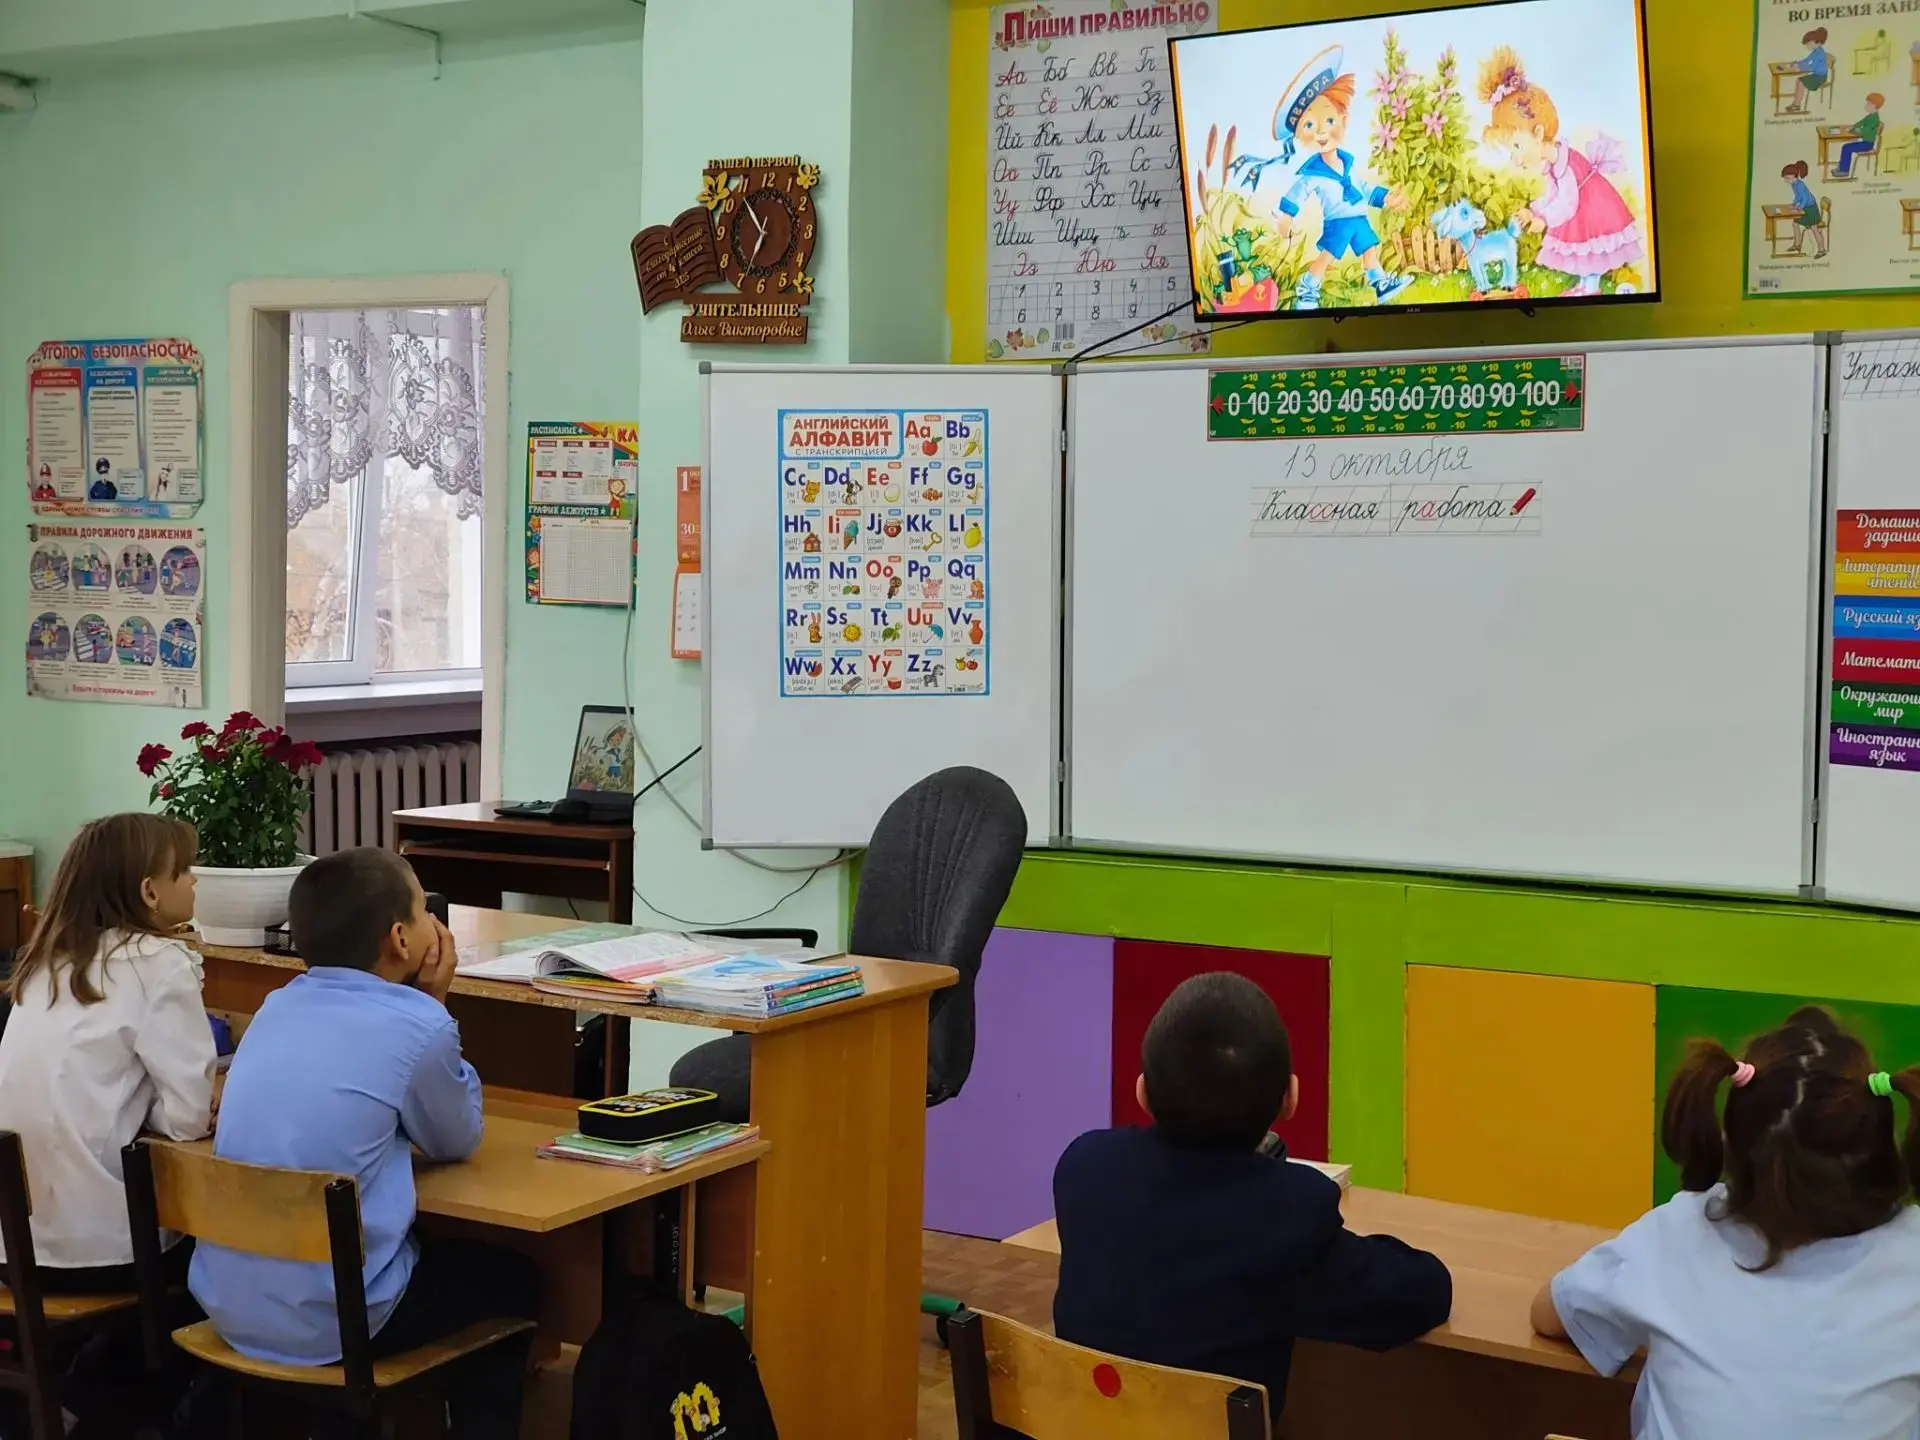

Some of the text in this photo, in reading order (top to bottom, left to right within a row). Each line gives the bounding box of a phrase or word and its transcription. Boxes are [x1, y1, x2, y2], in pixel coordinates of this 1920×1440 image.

[1079, 2, 1209, 33] ПРАВИЛЬНО
[1789, 10, 1809, 22] ВО
[1814, 4, 1871, 21] ВРЕМЯ
[996, 47, 1156, 86] Аа Бб Вв Гг
[994, 81, 1164, 119] Ее Ёё Жж Зз
[1289, 76, 1330, 125] АВРОРА
[996, 114, 1162, 150] Йй Кк Лл Мм
[709, 156, 800, 169] НАШЕЙ ПЕРВОЙ
[994, 147, 1150, 184] Оо Пп Рр Сс
[738, 176, 749, 193] 11
[762, 172, 776, 188] 12
[786, 177, 793, 193] 1
[721, 198, 735, 213] 10
[798, 196, 807, 211] 2
[993, 180, 1162, 221] Уу Фф Хх Цц
[716, 226, 725, 241] 9
[804, 224, 814, 239] 3
[994, 218, 1167, 247] Шш Щщ ъ ы
[720, 254, 729, 269] 8
[796, 252, 804, 268] 4
[1014, 246, 1169, 276] Ээ Юю Яя
[736, 274, 745, 288] 7
[756, 279, 765, 294] 6
[779, 273, 787, 287] 5
[1017, 277, 1176, 298] 1 2 3 4 5
[689, 303, 799, 317] УЧИТЕЛЬНИЦЕ
[1018, 309, 1026, 323] 6
[1055, 307, 1063, 320] 7
[1092, 306, 1100, 320] 8
[1128, 303, 1137, 317] 9
[682, 321, 803, 342] Ольге Викторовне
[40, 343, 193, 360] УГОЛОК БЕЗОПАСНОСТИ
[1242, 361, 1533, 382] +10 +10 +10 +10 +10 +10 +10 +10 +10 +10
[1228, 380, 1560, 417] 0 10 20 30 40 50 60 70 80 90 100
[794, 416, 889, 430] АНГЛИЙСКИЙ
[905, 420, 970, 438] Aa Bb
[1243, 419, 1531, 435] -10 -10 -10 -10 -10 -10 -10 -10 -10 -10
[789, 431, 892, 447] АЛФАВИТ
[805, 448, 887, 457] ТРАНСКРИПЦИЕЙ
[1285, 435, 1473, 481] 13 октября
[784, 466, 976, 490] Cc Dd Ee Ff Gg
[529, 506, 599, 515] ГРАФИК ДЕЖУРСТВ
[1261, 486, 1505, 532] Классная работа
[680, 523, 695, 537] 30
[784, 513, 965, 535] Hh Ii Jj Kk Ll
[40, 527, 192, 540] ПРАВИЛА ДОРОЖНОГО ДВИЖЕНИЯ
[784, 559, 975, 582] Mm Nn Oo Pp Qq
[1868, 579, 1920, 589] чтение
[786, 607, 973, 626] Rr Ss Tt Uu Vv
[1843, 607, 1903, 628] Русский
[785, 654, 932, 677] Ww Xx Yy Zz
[1874, 707, 1904, 724] мир
[1869, 749, 1907, 766] язык
